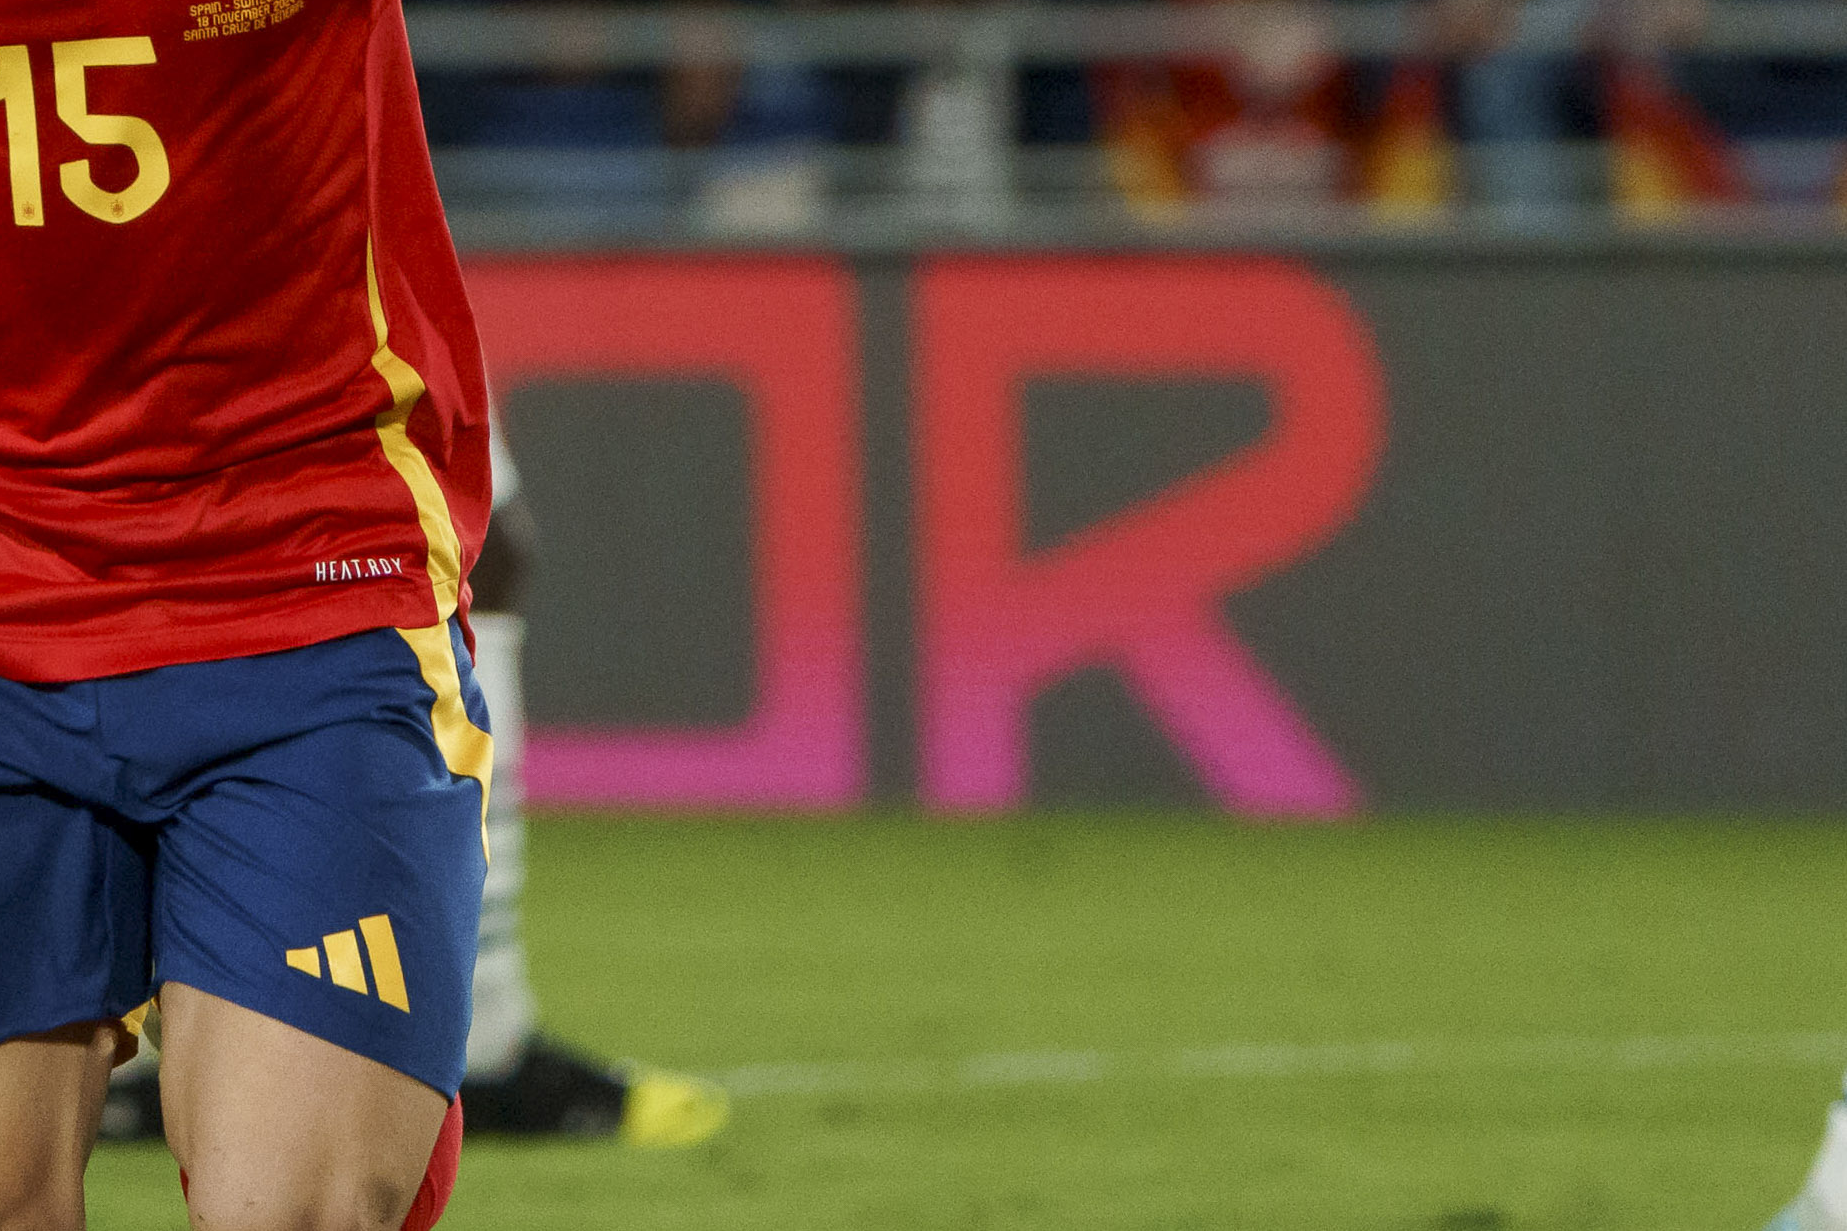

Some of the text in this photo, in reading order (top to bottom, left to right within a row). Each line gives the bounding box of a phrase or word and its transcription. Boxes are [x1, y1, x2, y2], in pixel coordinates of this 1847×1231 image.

[189, 1, 222, 17] SPAIN
[197, 16, 209, 27] 18
[213, 4, 270, 25] NOVEMBER
[183, 26, 219, 42] SANTA
[222, 21, 251, 36] CRUZ
[254, 16, 266, 30] DE
[315, 557, 403, 582] HEAT.RDY
